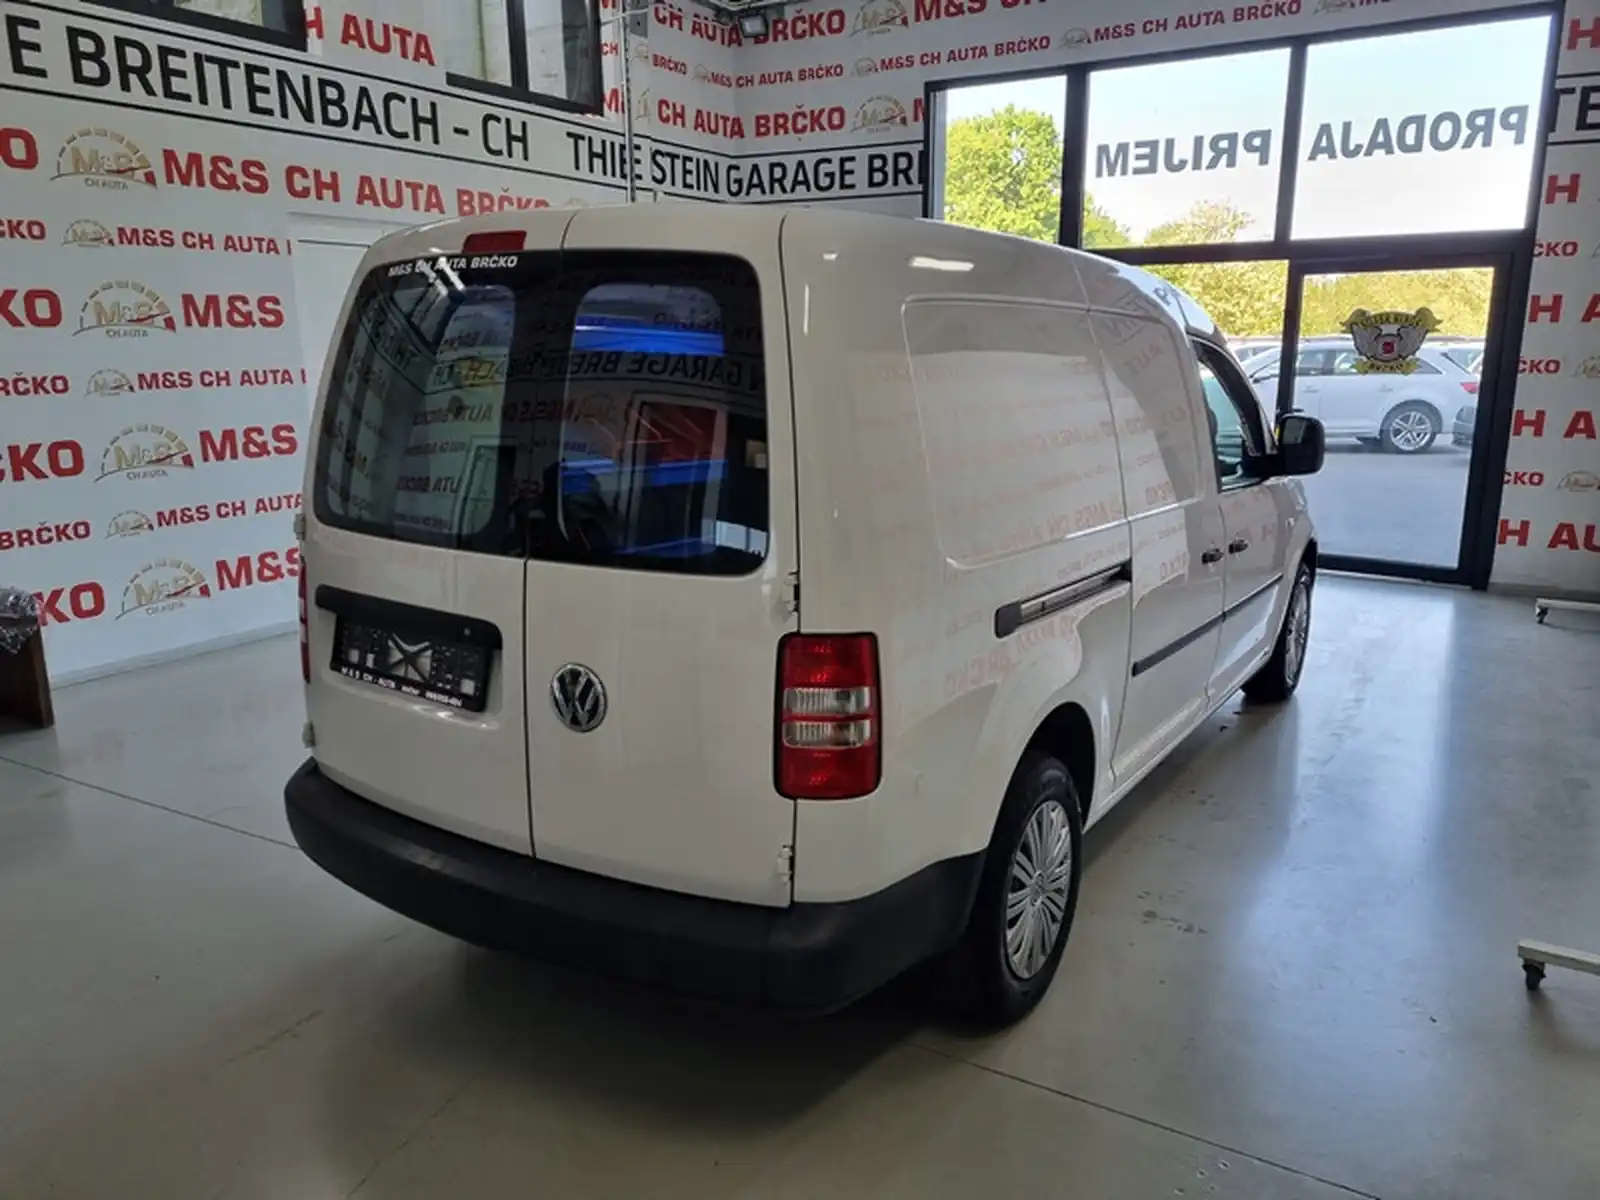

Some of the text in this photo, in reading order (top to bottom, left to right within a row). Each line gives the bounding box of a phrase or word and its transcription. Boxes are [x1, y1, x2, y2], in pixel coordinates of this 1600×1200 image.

[340, 13, 436, 66] AUTA
[755, 9, 846, 44] RČKO
[1093, 24, 1136, 42] M&S
[1143, 17, 1169, 34] CH
[1174, 10, 1226, 31] AUTA
[880, 57, 914, 71] M&S
[919, 51, 941, 67] CH
[946, 46, 989, 63] AUTA
[735, 75, 755, 88] CH
[758, 70, 793, 85] AUTA
[5, 15, 48, 79] E
[66, 26, 440, 146] BREITENBACH
[481, 113, 530, 161] CH
[727, 156, 857, 198] GARAGE
[657, 98, 687, 129] CH
[693, 109, 746, 140] AUTA
[754, 104, 846, 139] BRČKO
[162, 148, 270, 195] M&S
[284, 165, 341, 203] CH
[356, 174, 446, 215] AUTA
[1545, 173, 1580, 204] H
[0, 219, 46, 241] KO
[116, 227, 176, 248] M&S
[181, 230, 215, 251] CH
[223, 235, 281, 255] AUTA
[181, 293, 285, 329] M&S
[1528, 294, 1563, 324] H
[138, 370, 193, 391] M&S
[199, 370, 231, 388] CH
[240, 369, 293, 387] AUTA
[1512, 409, 1546, 437] H
[0, 440, 84, 483] KO
[199, 423, 298, 463] M&S
[0, 520, 91, 551] BRČKO
[156, 505, 211, 528] M&S
[216, 501, 246, 519] CH
[215, 547, 302, 592] M&S
